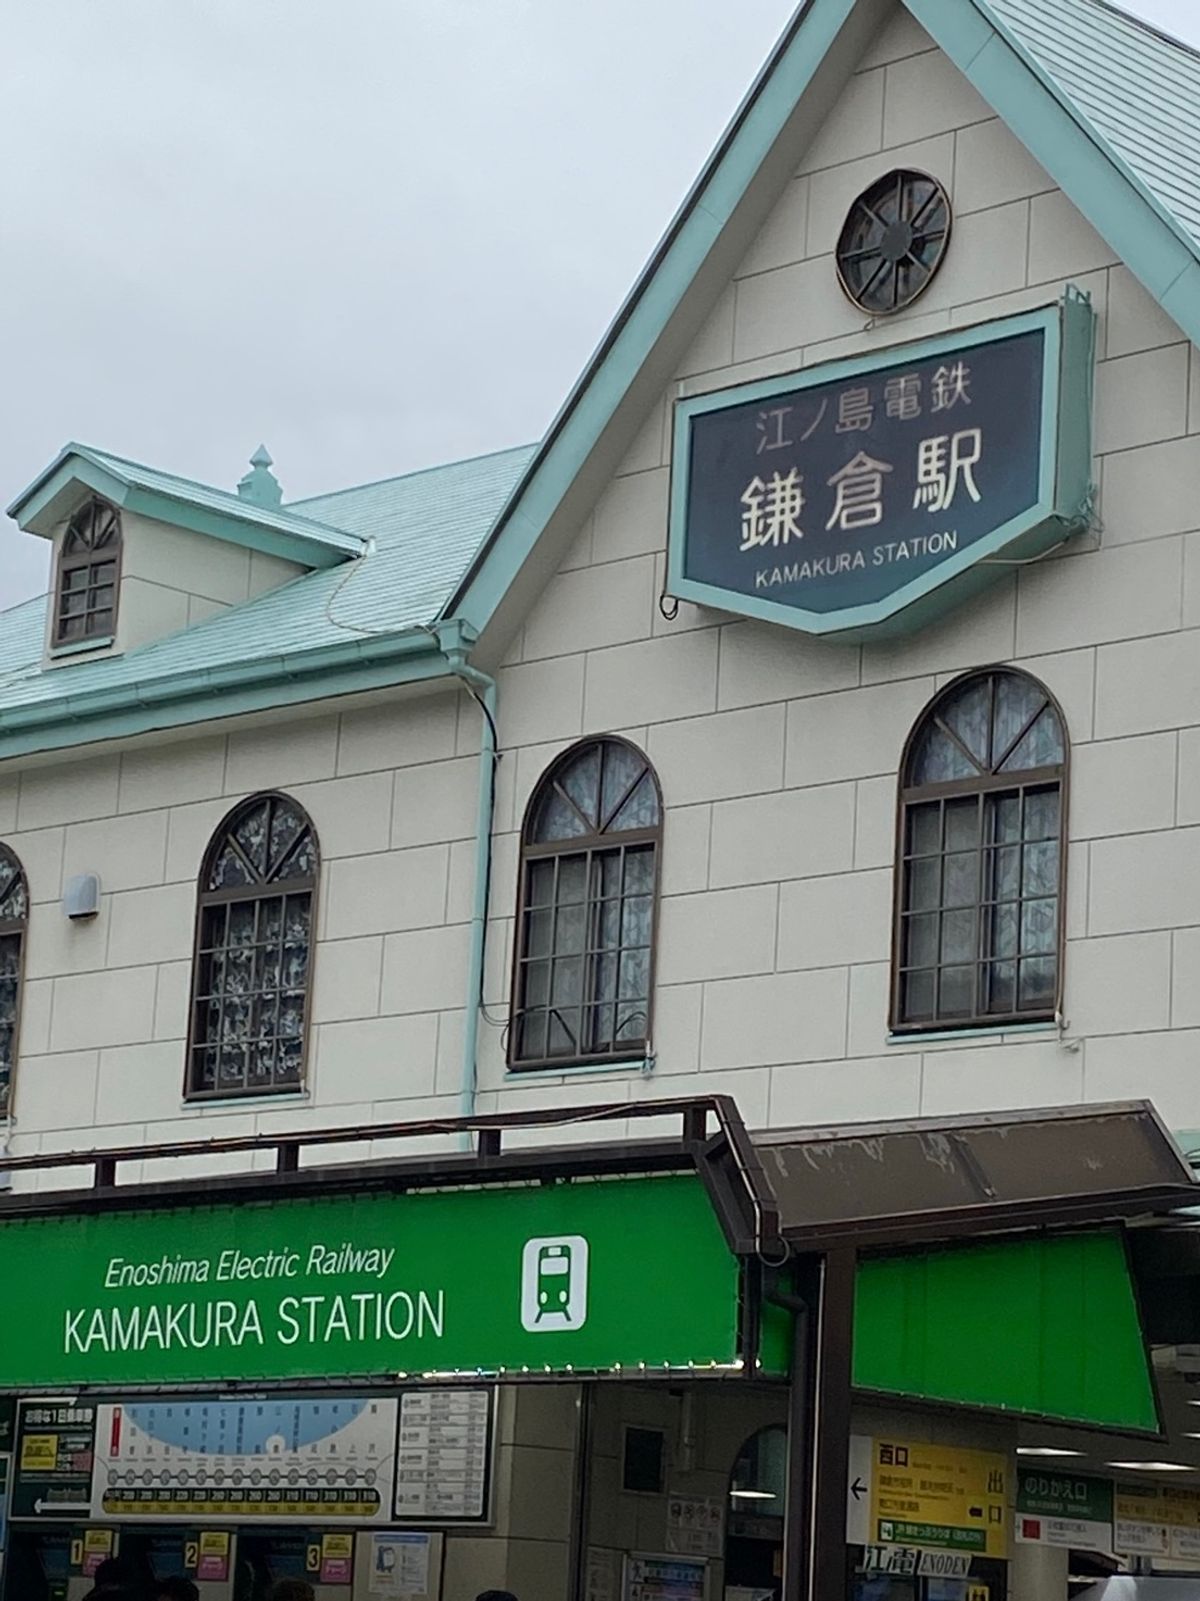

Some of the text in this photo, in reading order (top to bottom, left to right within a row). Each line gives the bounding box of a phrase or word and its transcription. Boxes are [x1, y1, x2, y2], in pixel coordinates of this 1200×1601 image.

[756, 361, 972, 454] 江ノ島電鉄
[739, 428, 982, 551] 鎌倉駅
[755, 530, 957, 588] KAMAKURA STATION
[104, 1243, 396, 1288] Enoshima Electric Railway
[64, 1290, 444, 1354] KAMAKURA STATION
[1025, 1477, 1087, 1500] のりかえ口
